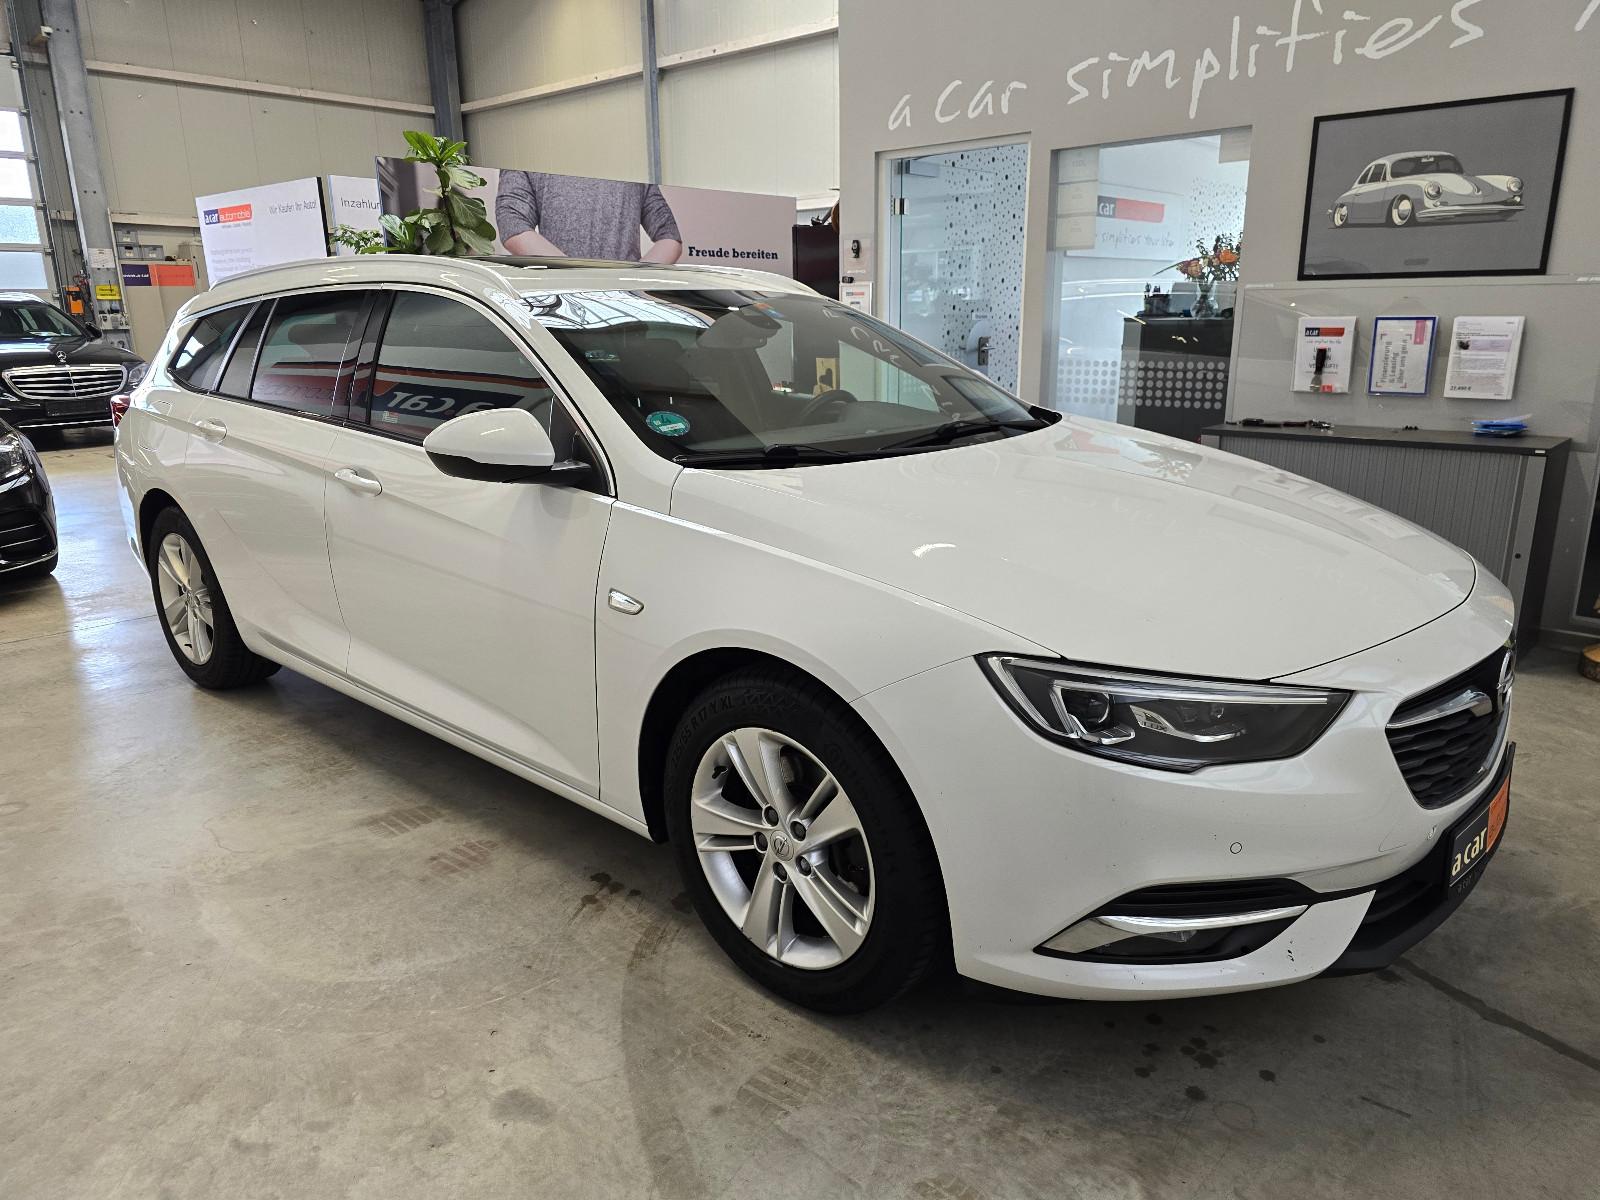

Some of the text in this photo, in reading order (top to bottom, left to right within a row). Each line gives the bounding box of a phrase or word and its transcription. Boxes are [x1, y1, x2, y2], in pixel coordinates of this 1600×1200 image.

[887, 0, 1485, 131] a car simplifies
[688, 246, 779, 260] Freude bereiten
